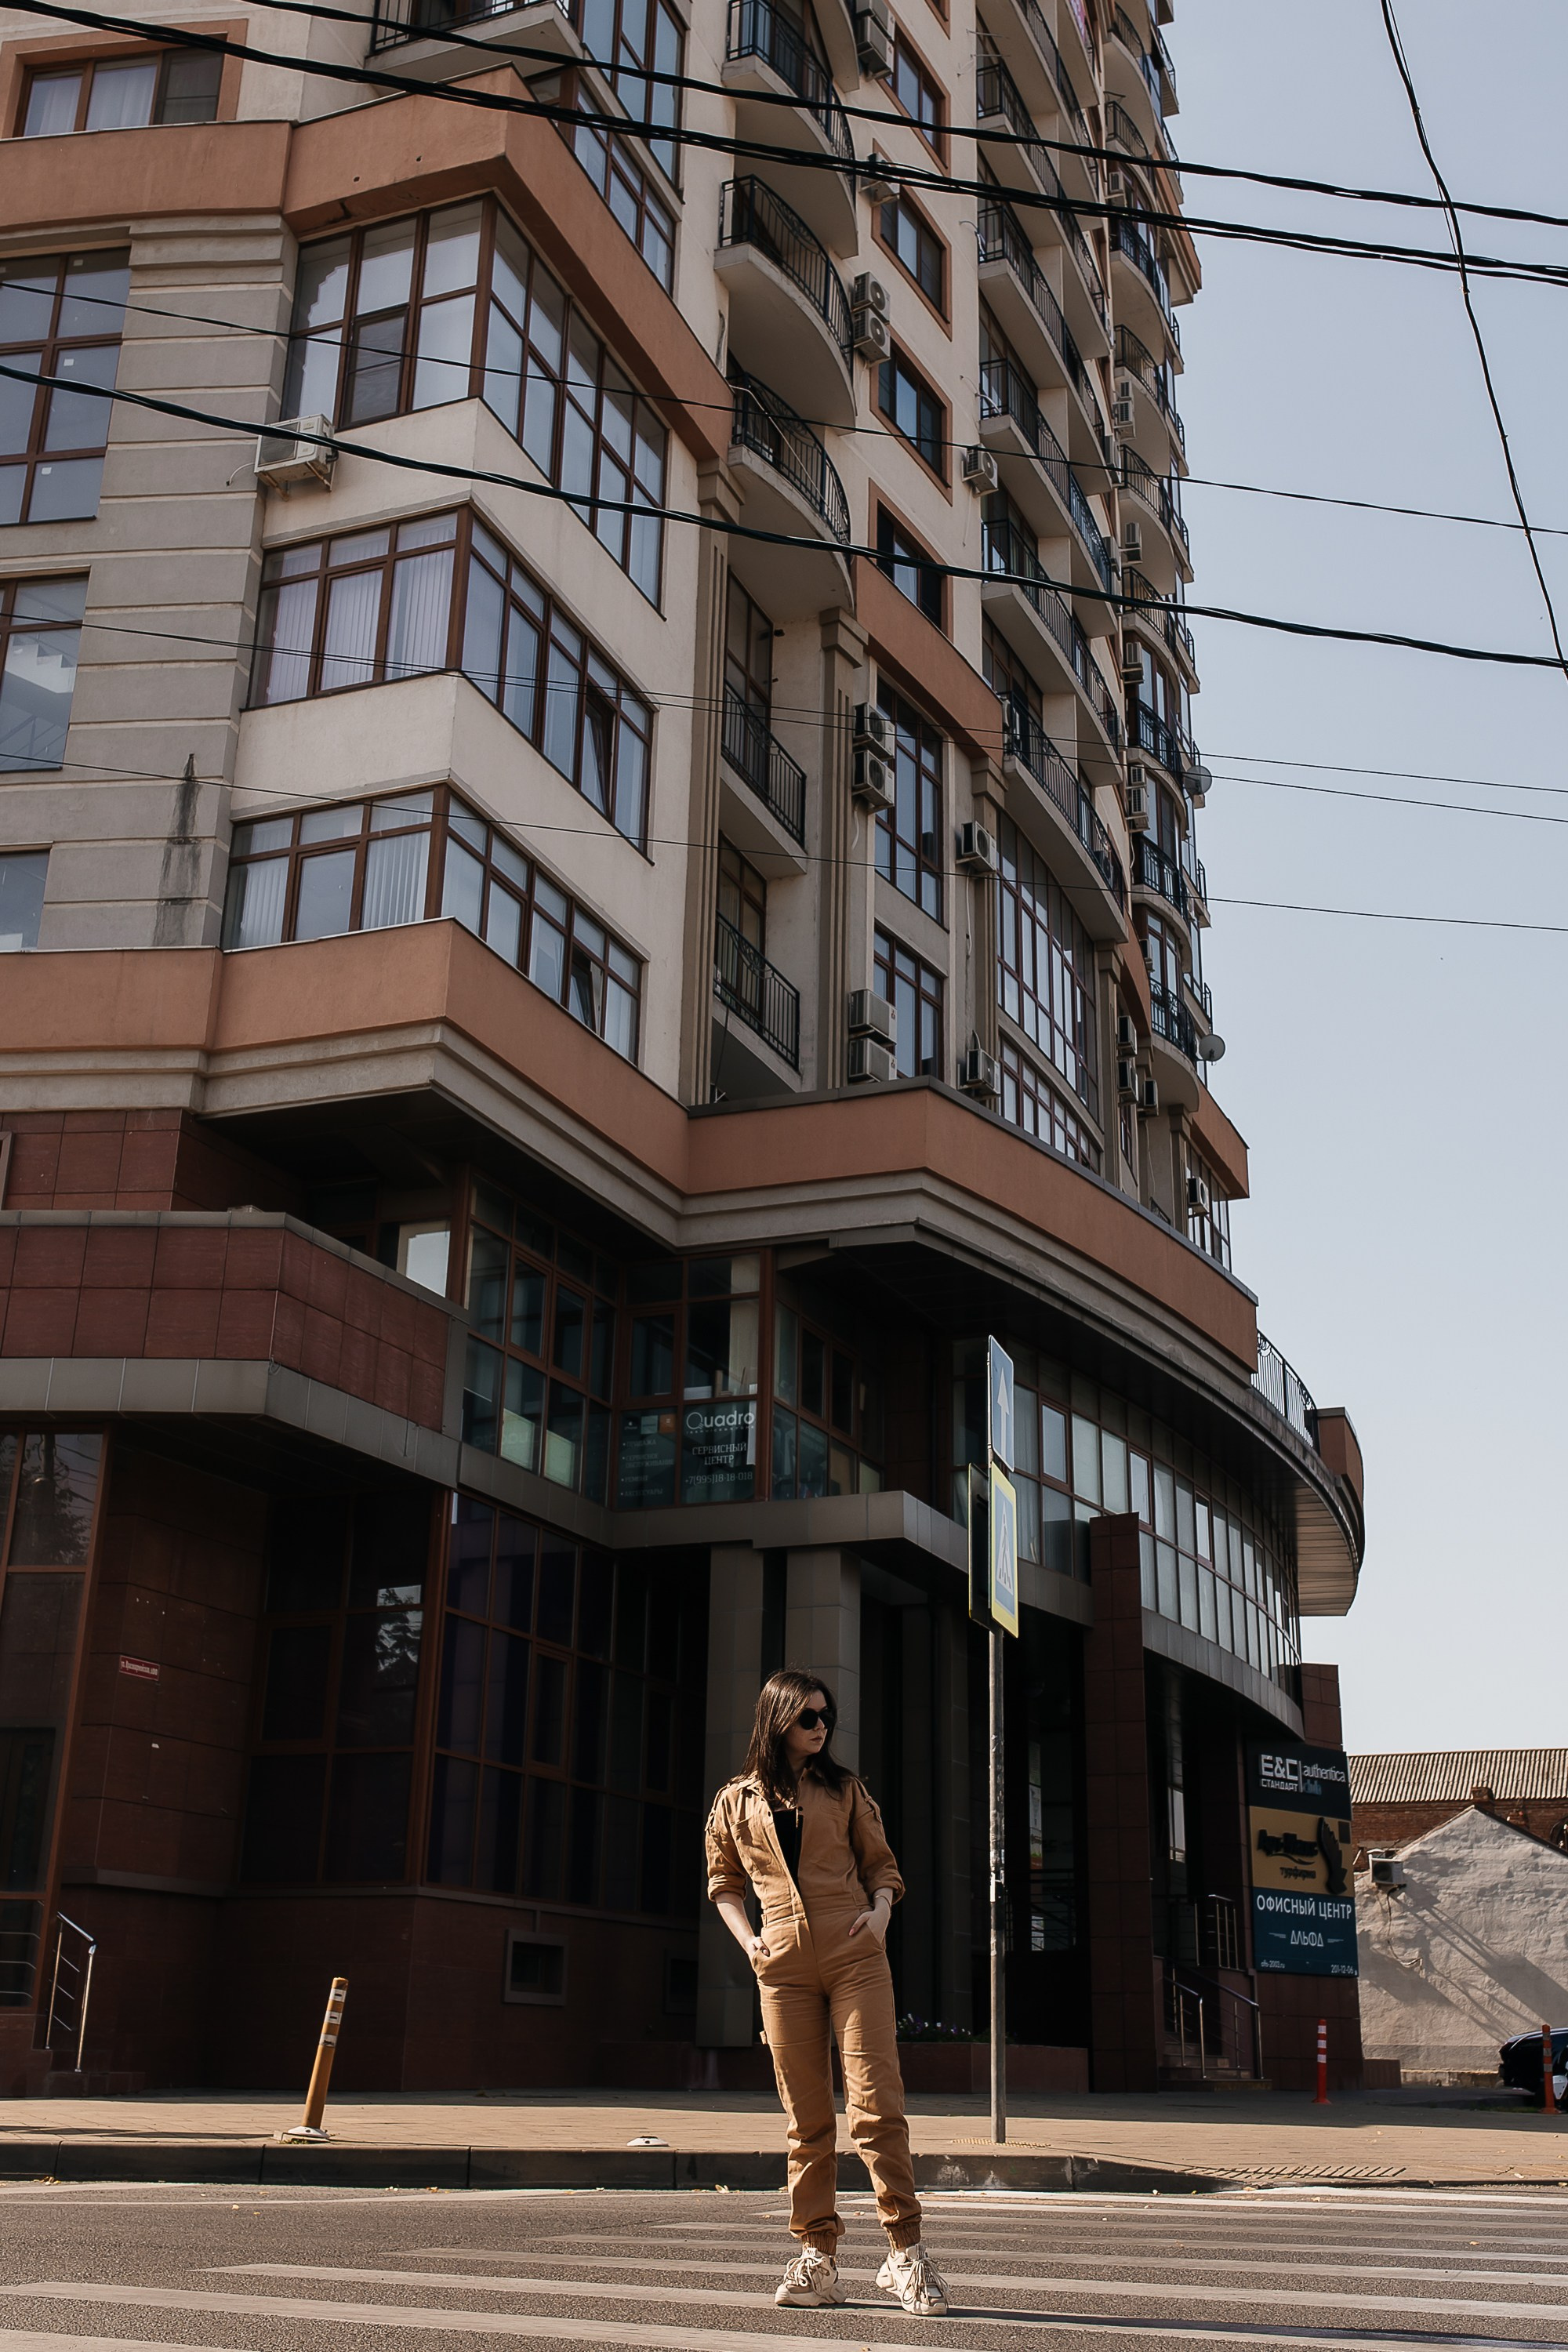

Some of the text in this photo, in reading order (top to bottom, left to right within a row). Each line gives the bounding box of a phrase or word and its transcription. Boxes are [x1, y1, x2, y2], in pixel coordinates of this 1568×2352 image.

[687, 1410, 754, 1429] Quadro
[692, 1443, 746, 1456] СЕРВИСНЫЙ
[704, 1455, 735, 1465] ЦЕНТР
[1303, 1763, 1346, 1783] authentica
[1261, 1778, 1298, 1792] СТАНДАРТ
[1257, 1894, 1352, 1920] ОФИСНЫЙ ЦЕНТР
